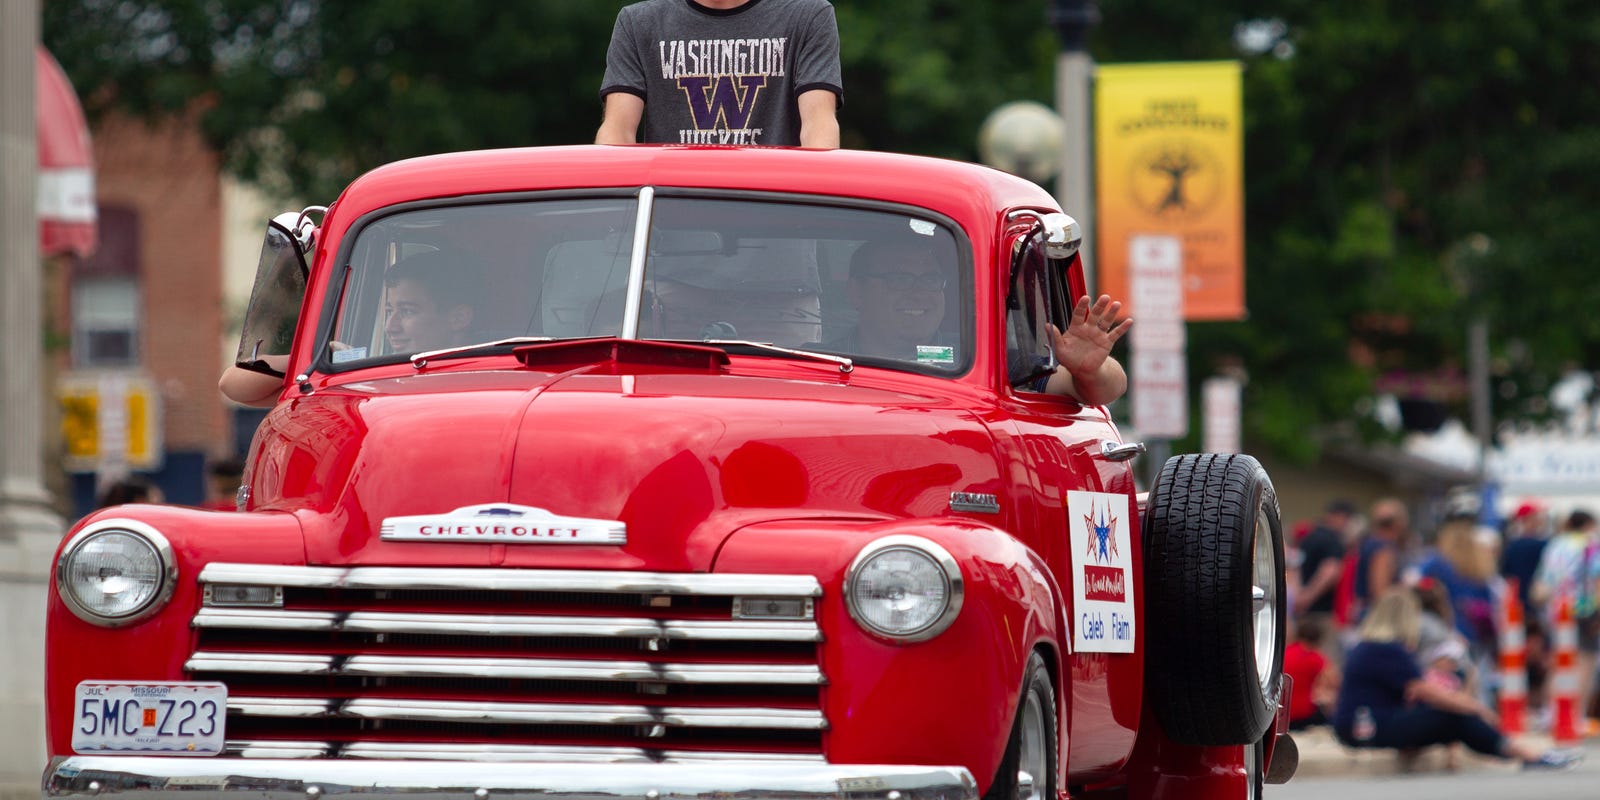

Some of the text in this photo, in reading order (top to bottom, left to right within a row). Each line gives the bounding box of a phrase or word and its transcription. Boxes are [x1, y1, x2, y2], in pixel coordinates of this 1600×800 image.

[659, 37, 786, 79] WASHINGTON
[677, 73, 767, 132] W
[419, 525, 581, 537] CHEVROLET
[1082, 612, 1130, 640] Caleb Flaim
[85, 687, 103, 695] JUL
[81, 699, 217, 737] 5MC Z23
